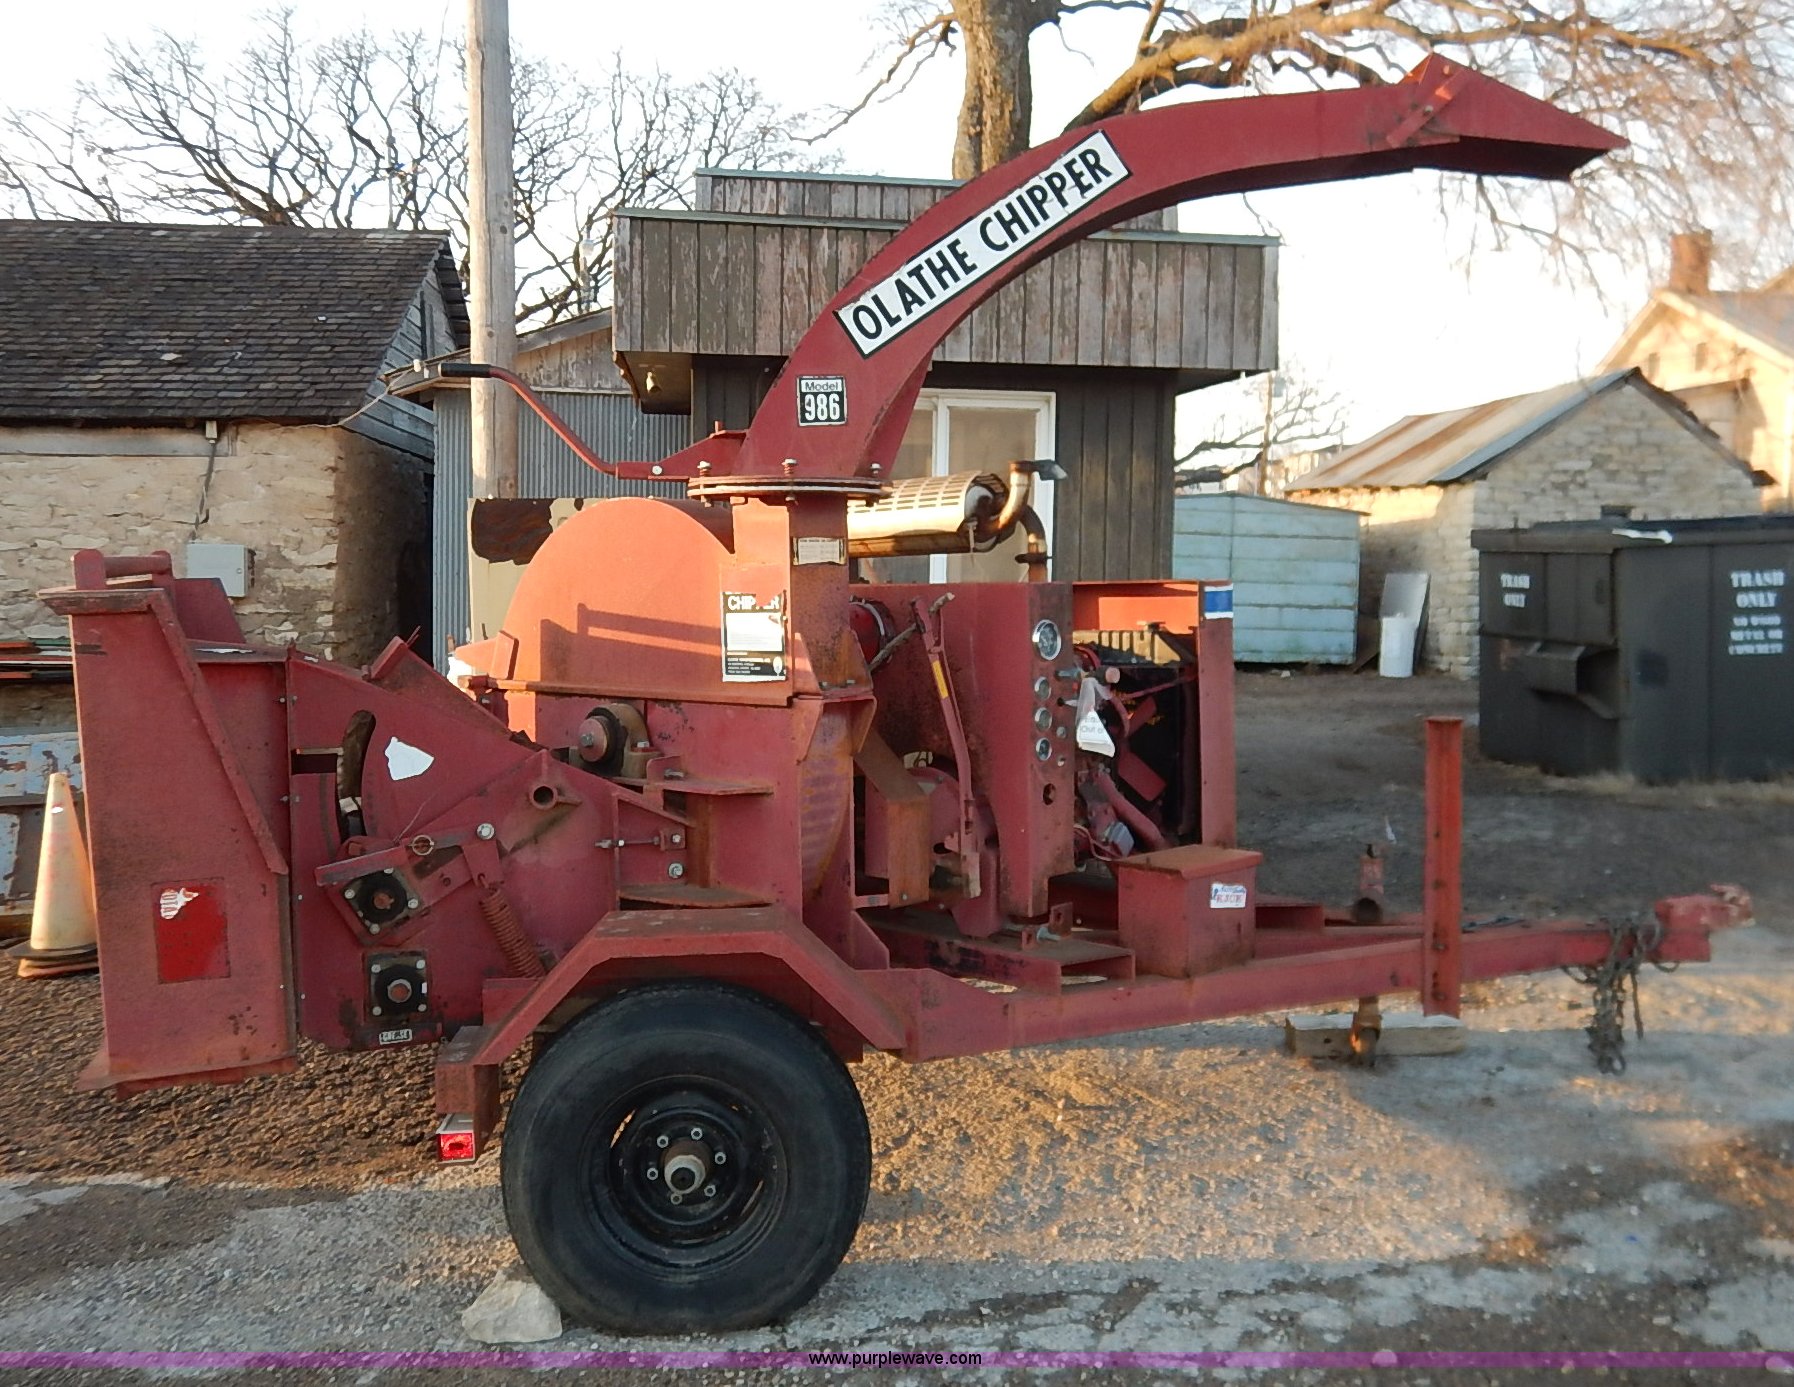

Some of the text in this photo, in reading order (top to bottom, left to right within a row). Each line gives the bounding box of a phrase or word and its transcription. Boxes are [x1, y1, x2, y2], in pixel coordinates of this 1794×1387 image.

[851, 147, 1113, 340] OLATHE CHIPPER
[805, 381, 839, 392] Model
[804, 393, 841, 421] 986
[1730, 570, 1784, 588] TRASH
[727, 595, 780, 610] CHIPR
[1735, 591, 1777, 608] ONLY
